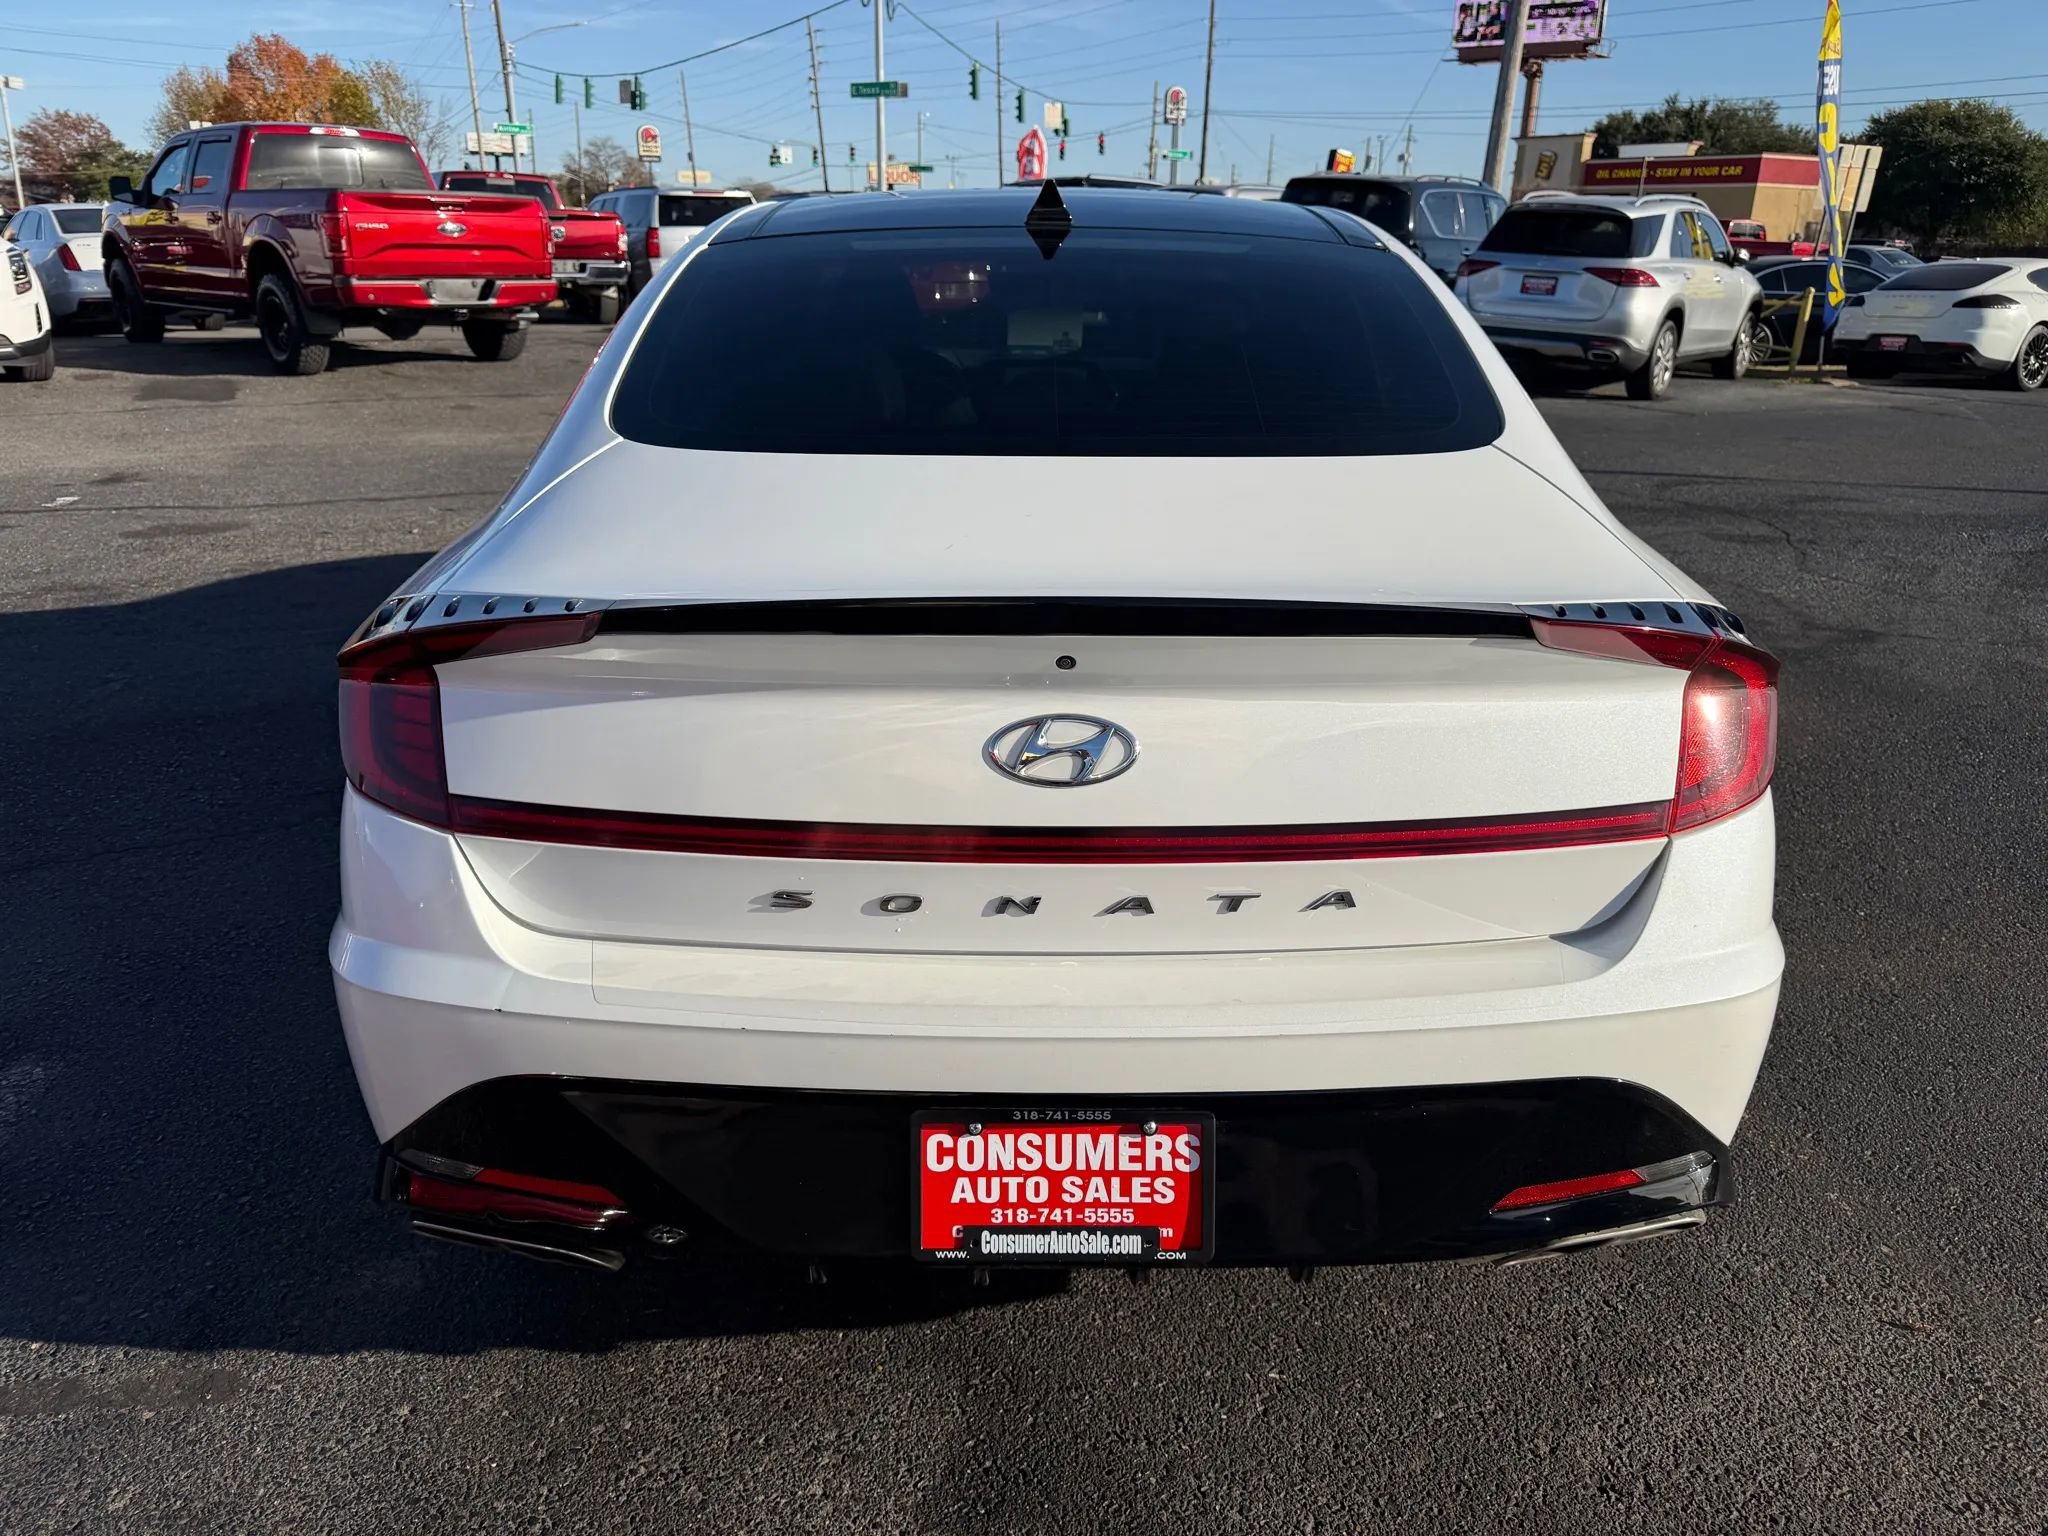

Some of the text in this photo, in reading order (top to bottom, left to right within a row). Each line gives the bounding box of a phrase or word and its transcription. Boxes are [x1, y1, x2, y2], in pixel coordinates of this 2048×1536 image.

[1596, 169, 1610, 179] OIL
[1655, 167, 1679, 178] STAY
[1680, 167, 1691, 177] IN
[1694, 166, 1719, 177] YOUR
[1721, 165, 1744, 176] CAR
[768, 888, 1357, 915] SONATA
[1013, 1111, 1112, 1120] 318-741-5555
[926, 1133, 1201, 1173] CONSUMERS
[950, 1176, 1175, 1204] AUTO SALES
[990, 1208, 1135, 1223] 318-741-5555
[981, 1230, 1142, 1254] ConsumerAutoSale.com
[1153, 1251, 1187, 1260] .COM
